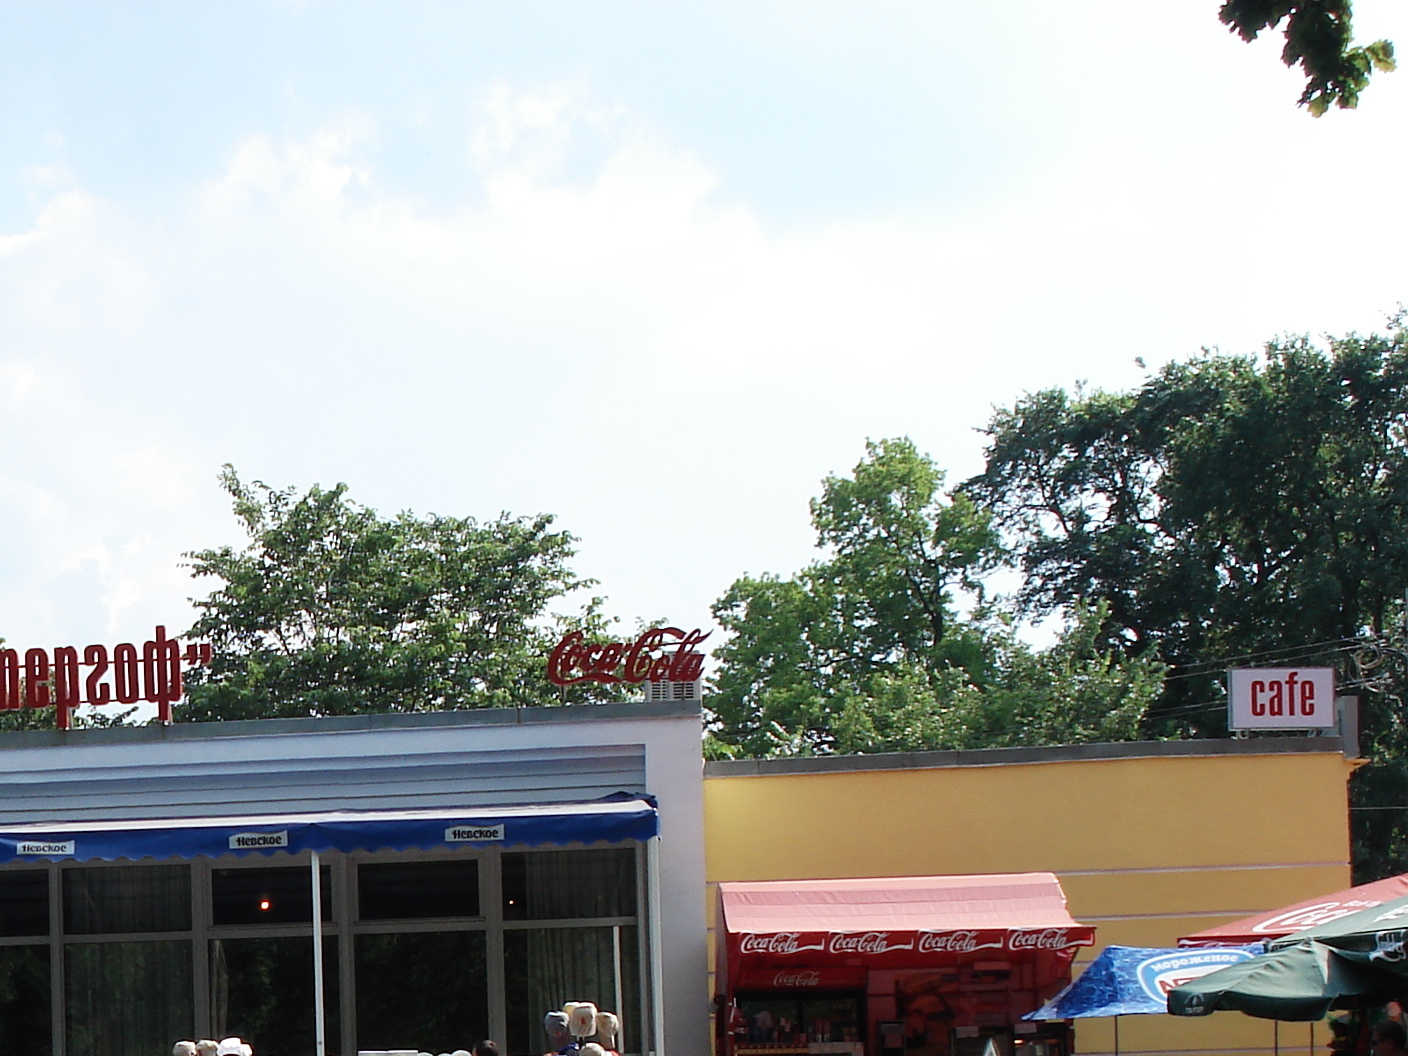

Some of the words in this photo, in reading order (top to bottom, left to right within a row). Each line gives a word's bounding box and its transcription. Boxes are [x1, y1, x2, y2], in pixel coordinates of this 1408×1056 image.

[548, 626, 713, 685] Coca-Cola
[1251, 672, 1314, 717] cafe
[741, 932, 801, 954] Coca-Cola
[830, 932, 890, 954] Coca-Cola
[919, 931, 980, 952] Coca-Cola
[1009, 929, 1070, 951] Coca-Cola
[773, 971, 819, 986] Coca-Cola
